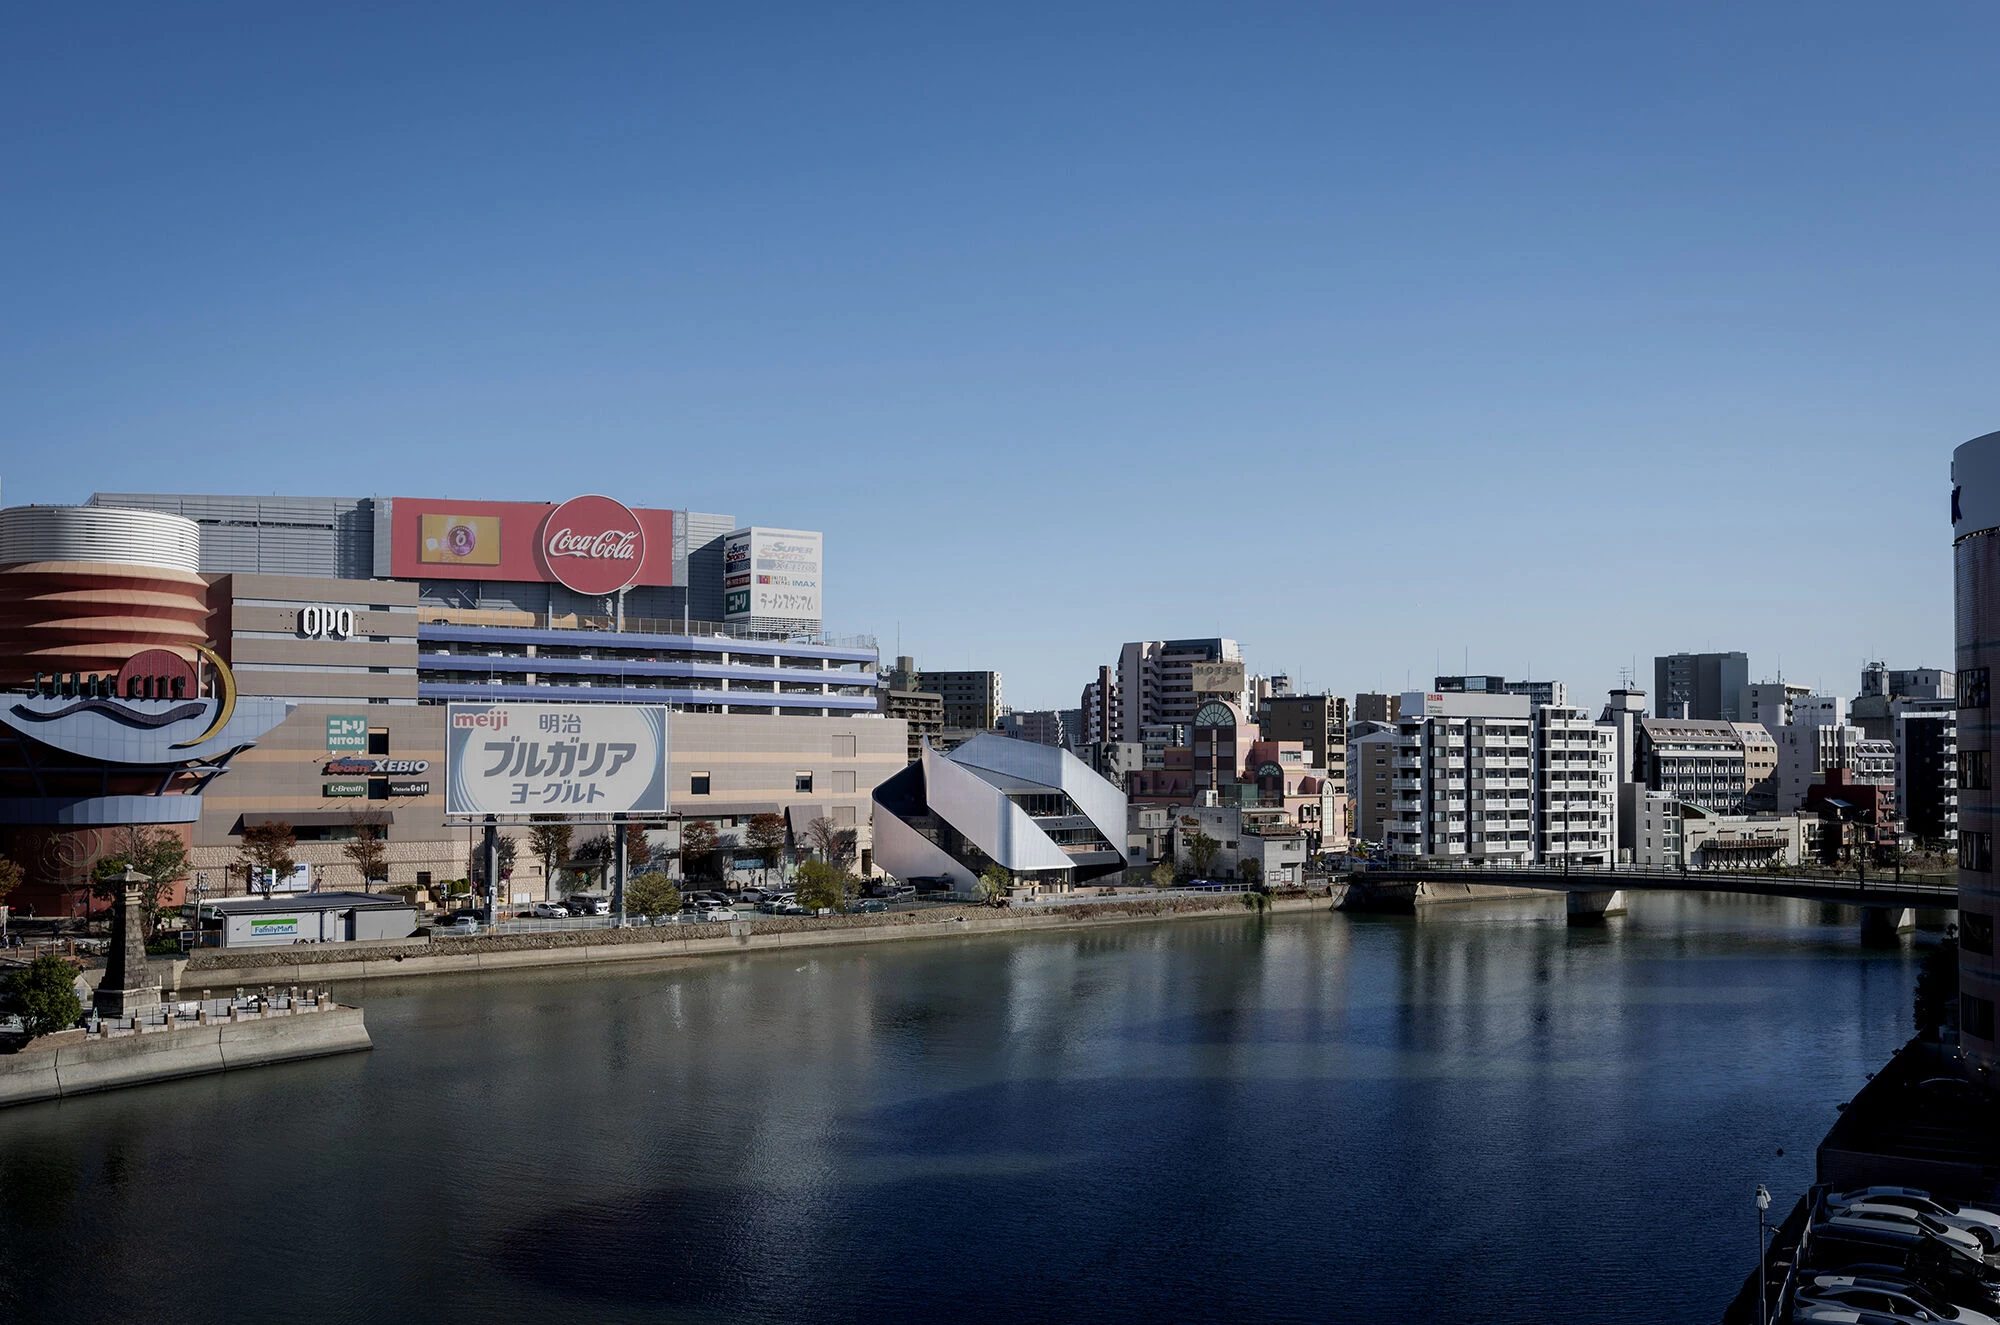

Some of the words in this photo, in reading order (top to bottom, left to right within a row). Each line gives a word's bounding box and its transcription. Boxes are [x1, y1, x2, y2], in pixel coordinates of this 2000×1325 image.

[549, 528, 640, 559] Coca-Cola
[772, 542, 813, 554] SUPER
[728, 593, 746, 611] ニトリ
[34, 672, 116, 697] CANAL
[133, 674, 186, 698] CITY
[329, 720, 364, 735] ニトリ
[454, 711, 509, 731] meiji
[539, 714, 581, 734] 明治
[329, 737, 364, 745] NITORI
[371, 758, 429, 772] XEBIO
[483, 736, 637, 778] ブルガリア
[410, 784, 428, 792] Golf
[510, 780, 605, 804] ヨーグルト
[254, 925, 294, 934] FamilyMart
